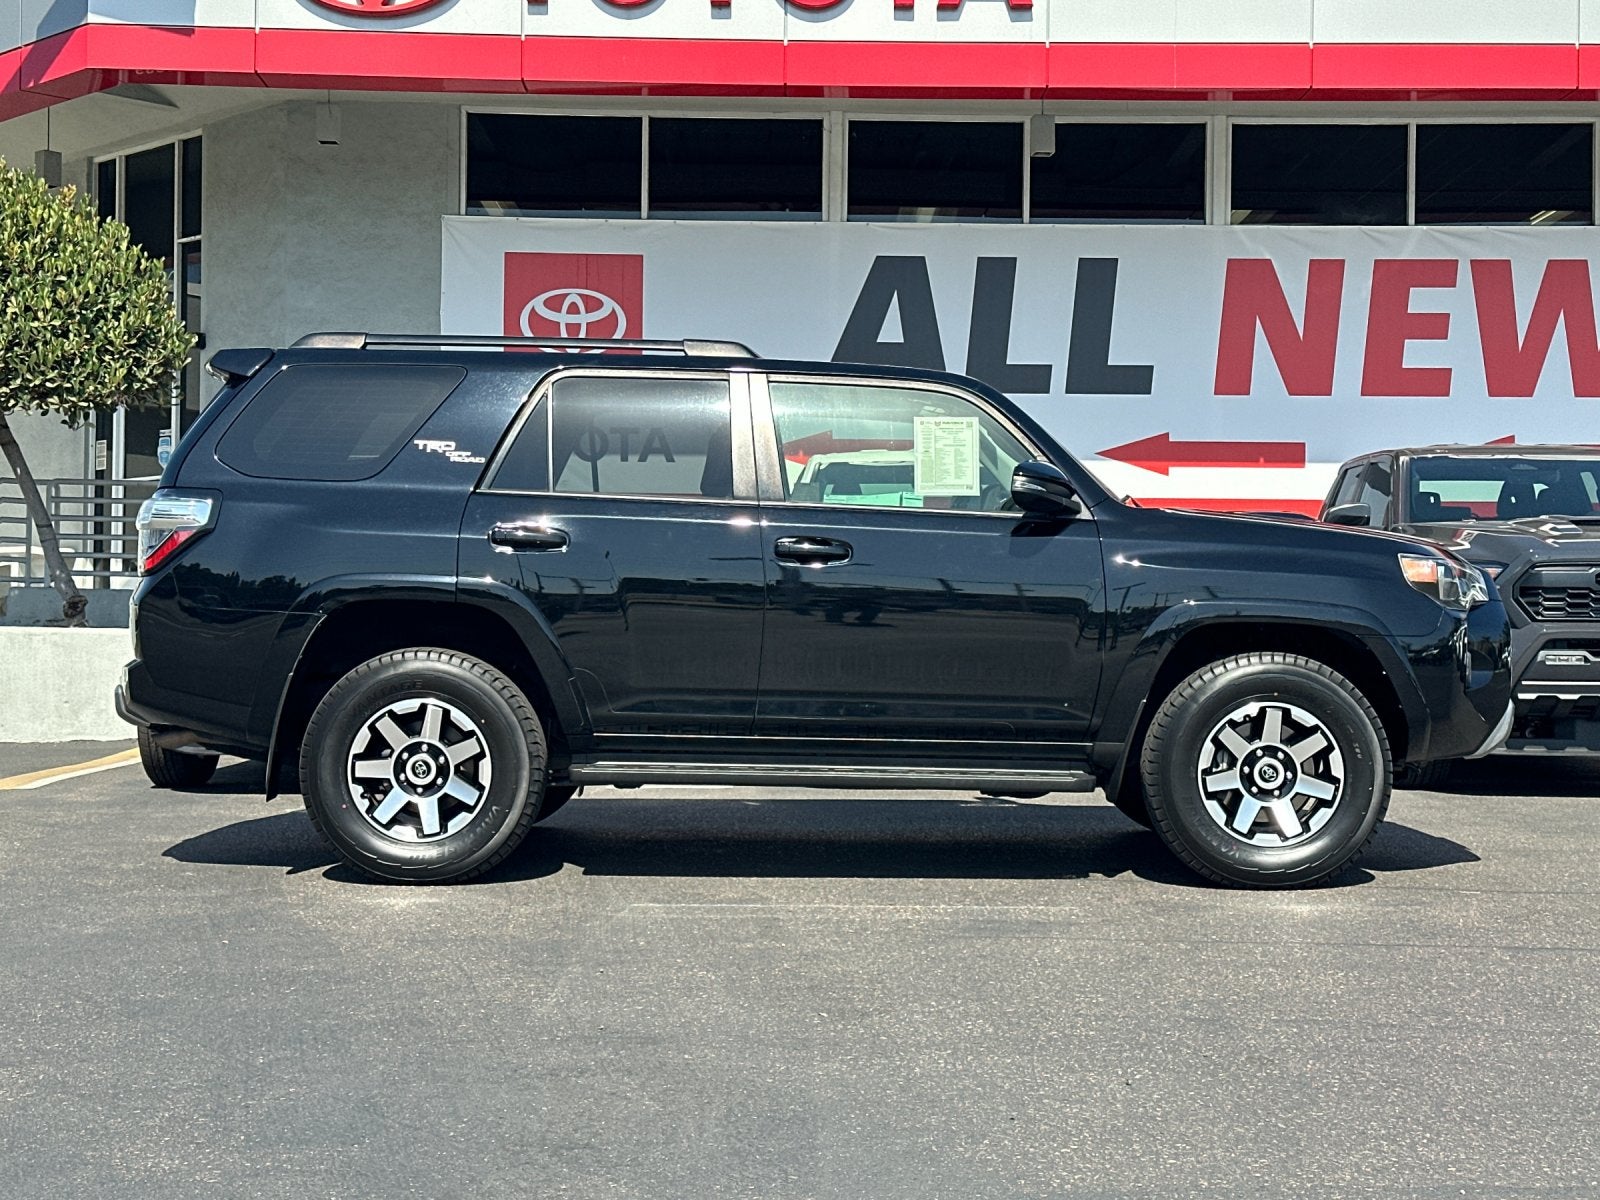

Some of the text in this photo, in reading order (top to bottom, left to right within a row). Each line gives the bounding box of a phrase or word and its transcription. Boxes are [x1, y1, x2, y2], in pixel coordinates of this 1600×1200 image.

[831, 255, 1600, 397] ALL NEW
[413, 439, 456, 453] TRD
[574, 426, 676, 463] OTA
